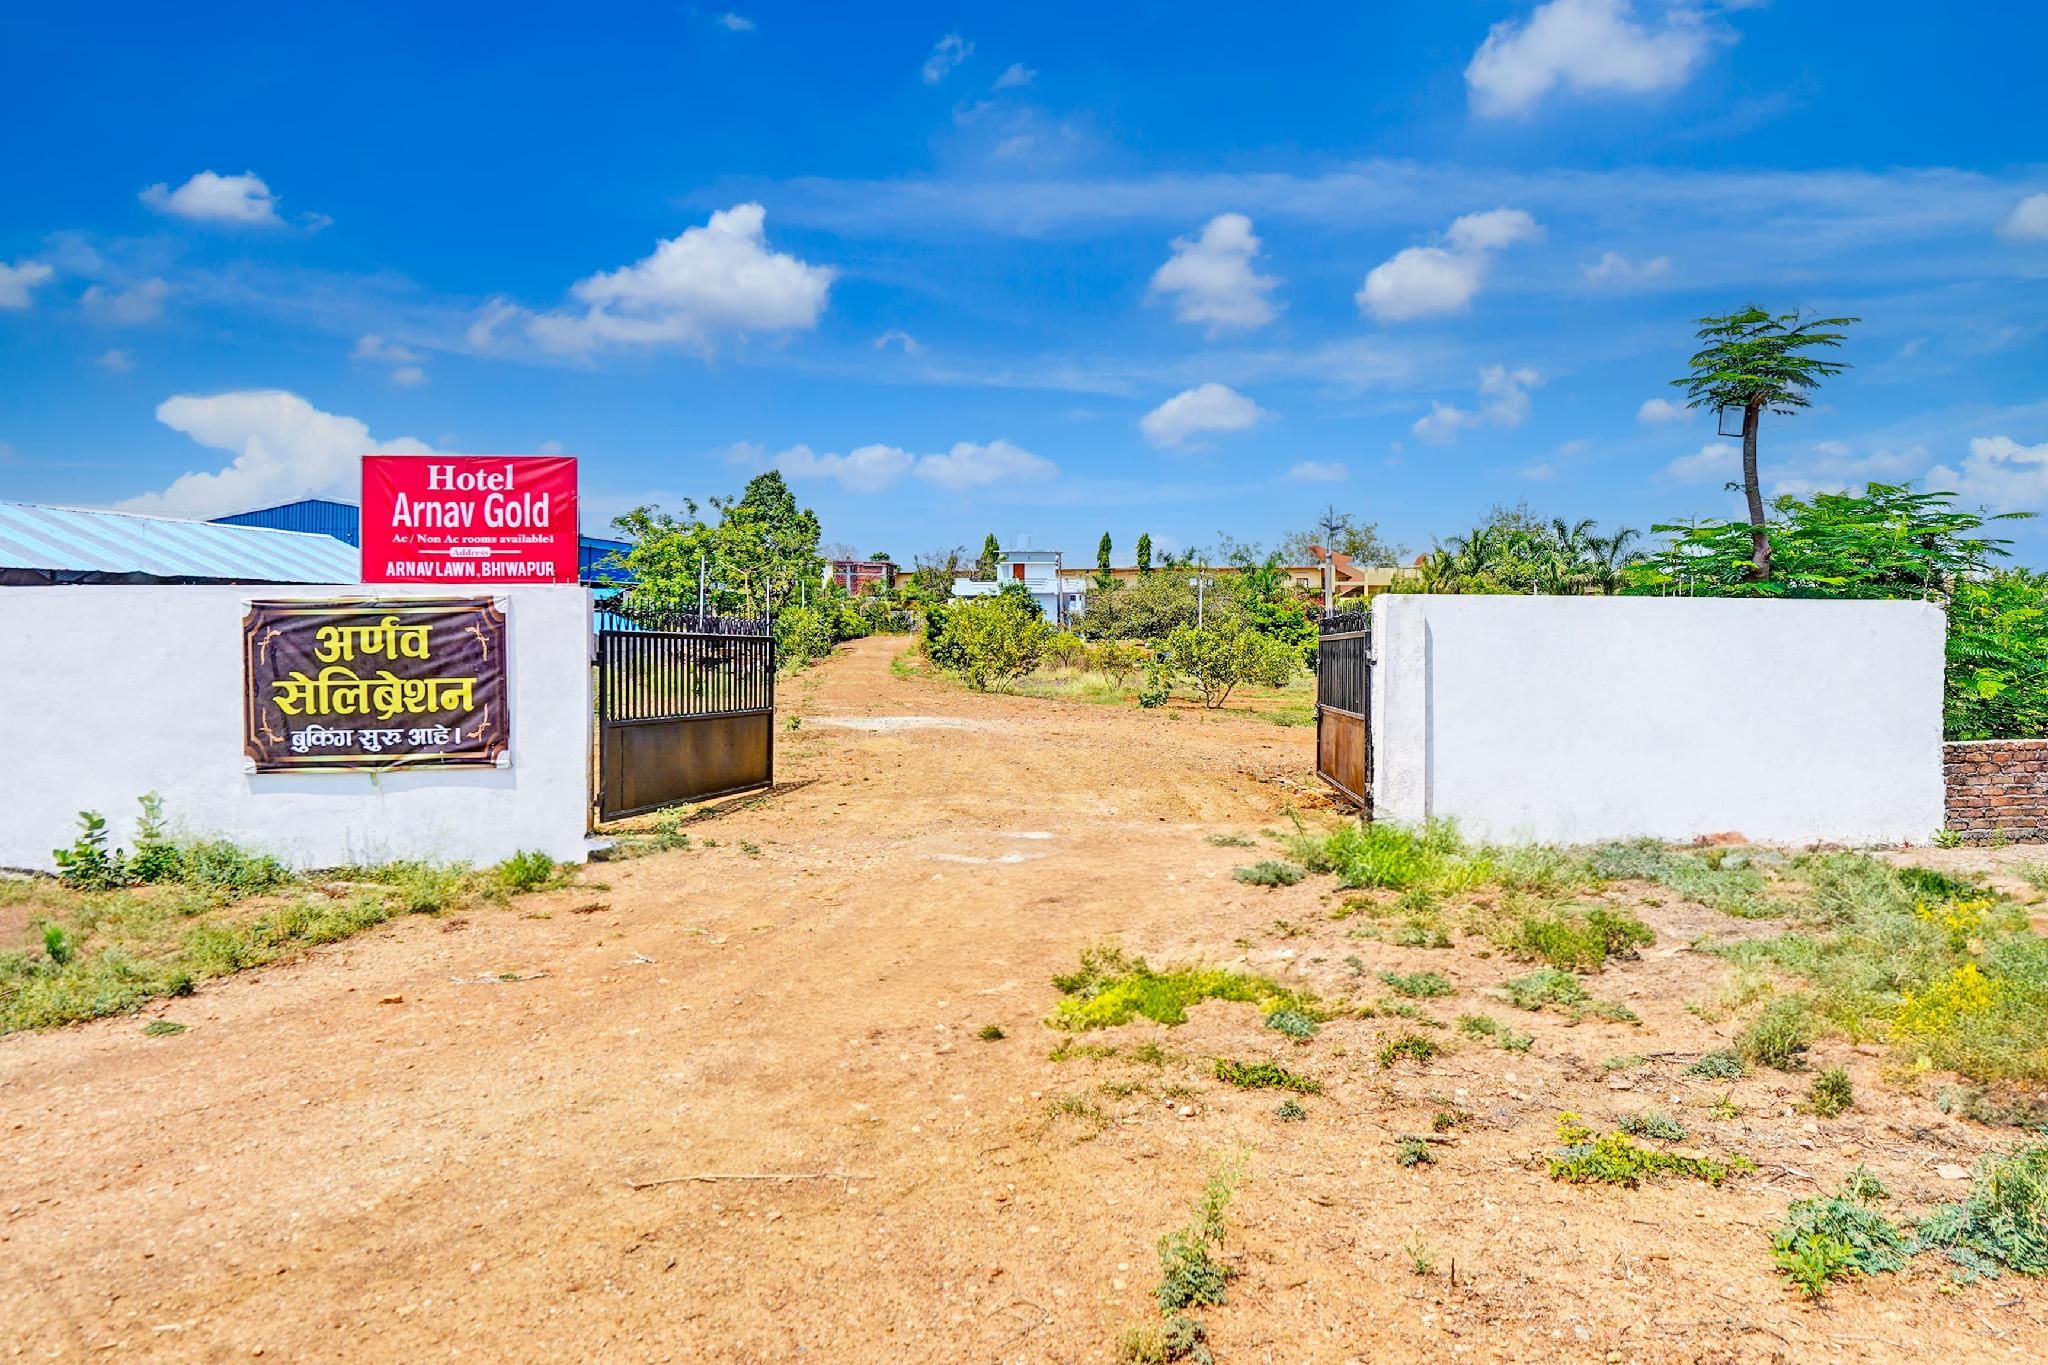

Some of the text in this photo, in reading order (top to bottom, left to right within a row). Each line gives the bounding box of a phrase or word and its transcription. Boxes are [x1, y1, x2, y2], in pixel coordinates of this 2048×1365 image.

[427, 464, 515, 491] Hotel
[392, 492, 549, 528] Arnav Gold
[392, 533, 408, 543] Ac
[416, 533, 442, 544] Non
[443, 534, 460, 544] Ac
[462, 535, 498, 544] rooms
[452, 548, 490, 556] Address
[385, 561, 434, 577] ARNAV
[482, 561, 556, 577] BHIWAPUR
[314, 616, 433, 663] अर्णव
[272, 665, 477, 720] सेलिब्रेशन
[290, 724, 354, 753] बुकिंग
